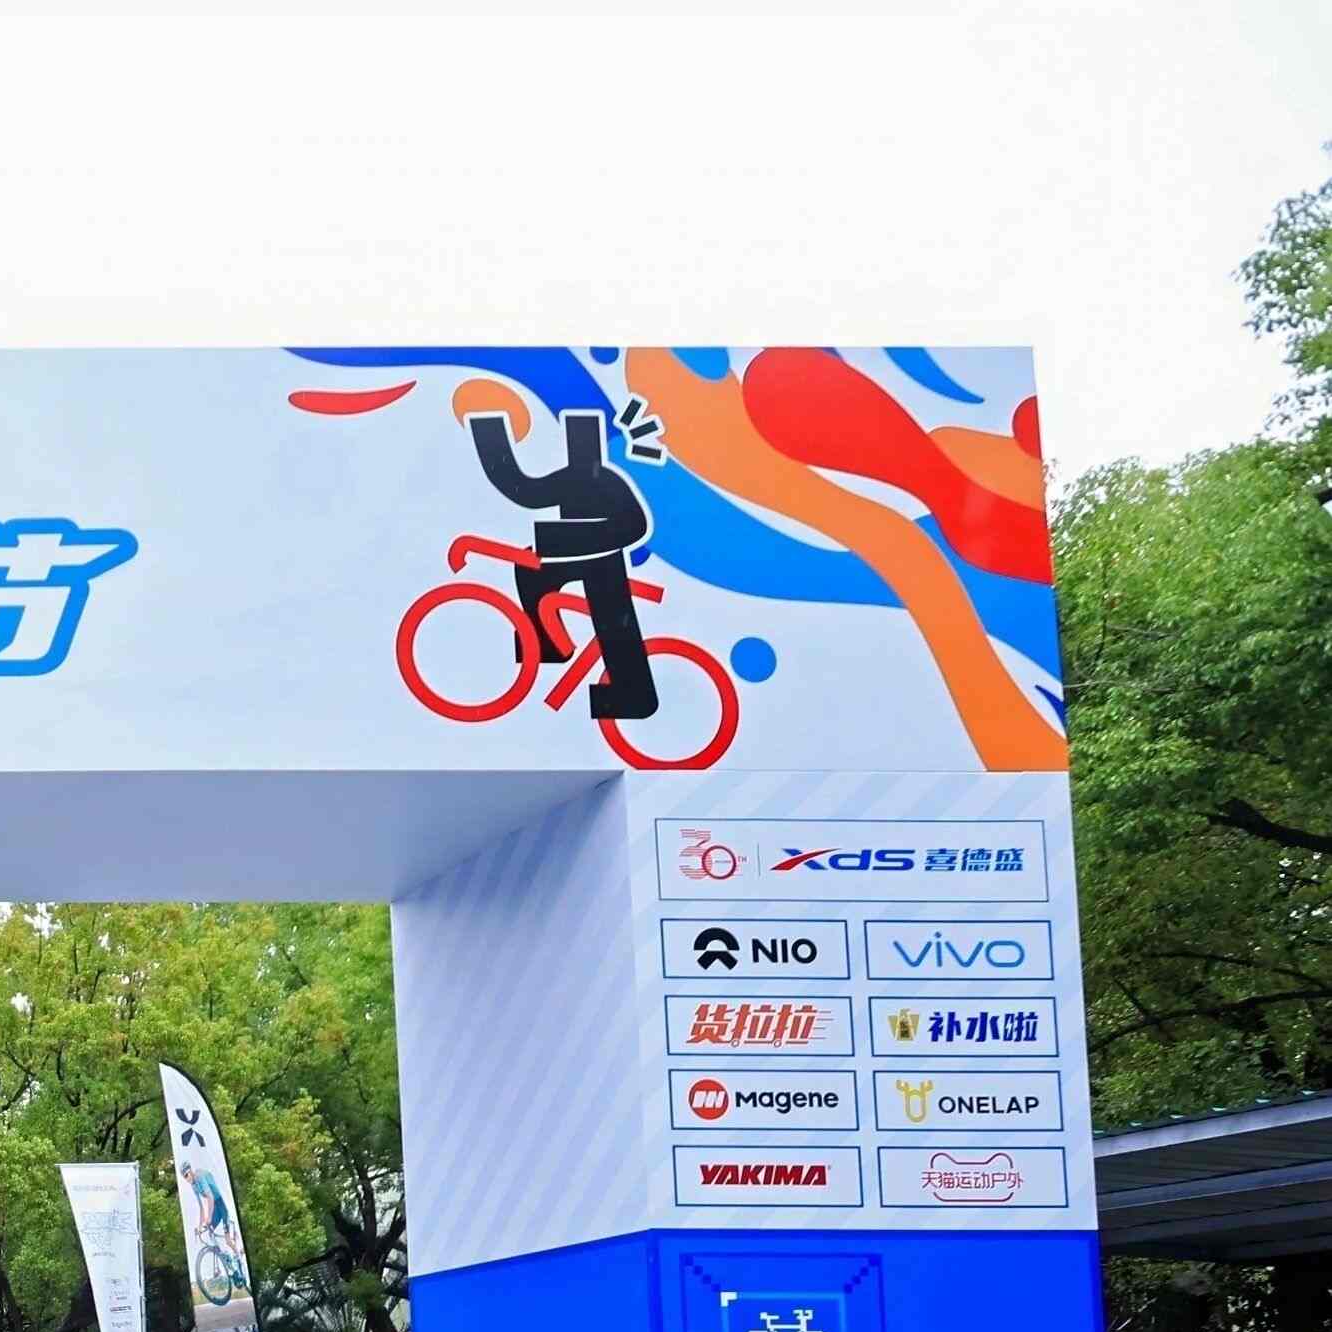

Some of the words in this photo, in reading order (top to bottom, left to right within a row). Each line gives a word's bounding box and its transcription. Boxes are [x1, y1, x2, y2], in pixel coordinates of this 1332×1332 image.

[924, 848, 1025, 872] 喜德盛
[751, 938, 818, 964] NIO
[893, 932, 1025, 968] vivo
[686, 1004, 819, 1047] 货拉拉
[928, 1012, 1038, 1043] 补水啦
[735, 1091, 839, 1114] Magene
[938, 1097, 1039, 1114] ONELAP
[700, 1165, 828, 1186] YAKIMA
[921, 1172, 1024, 1190] 天猫运动户外
